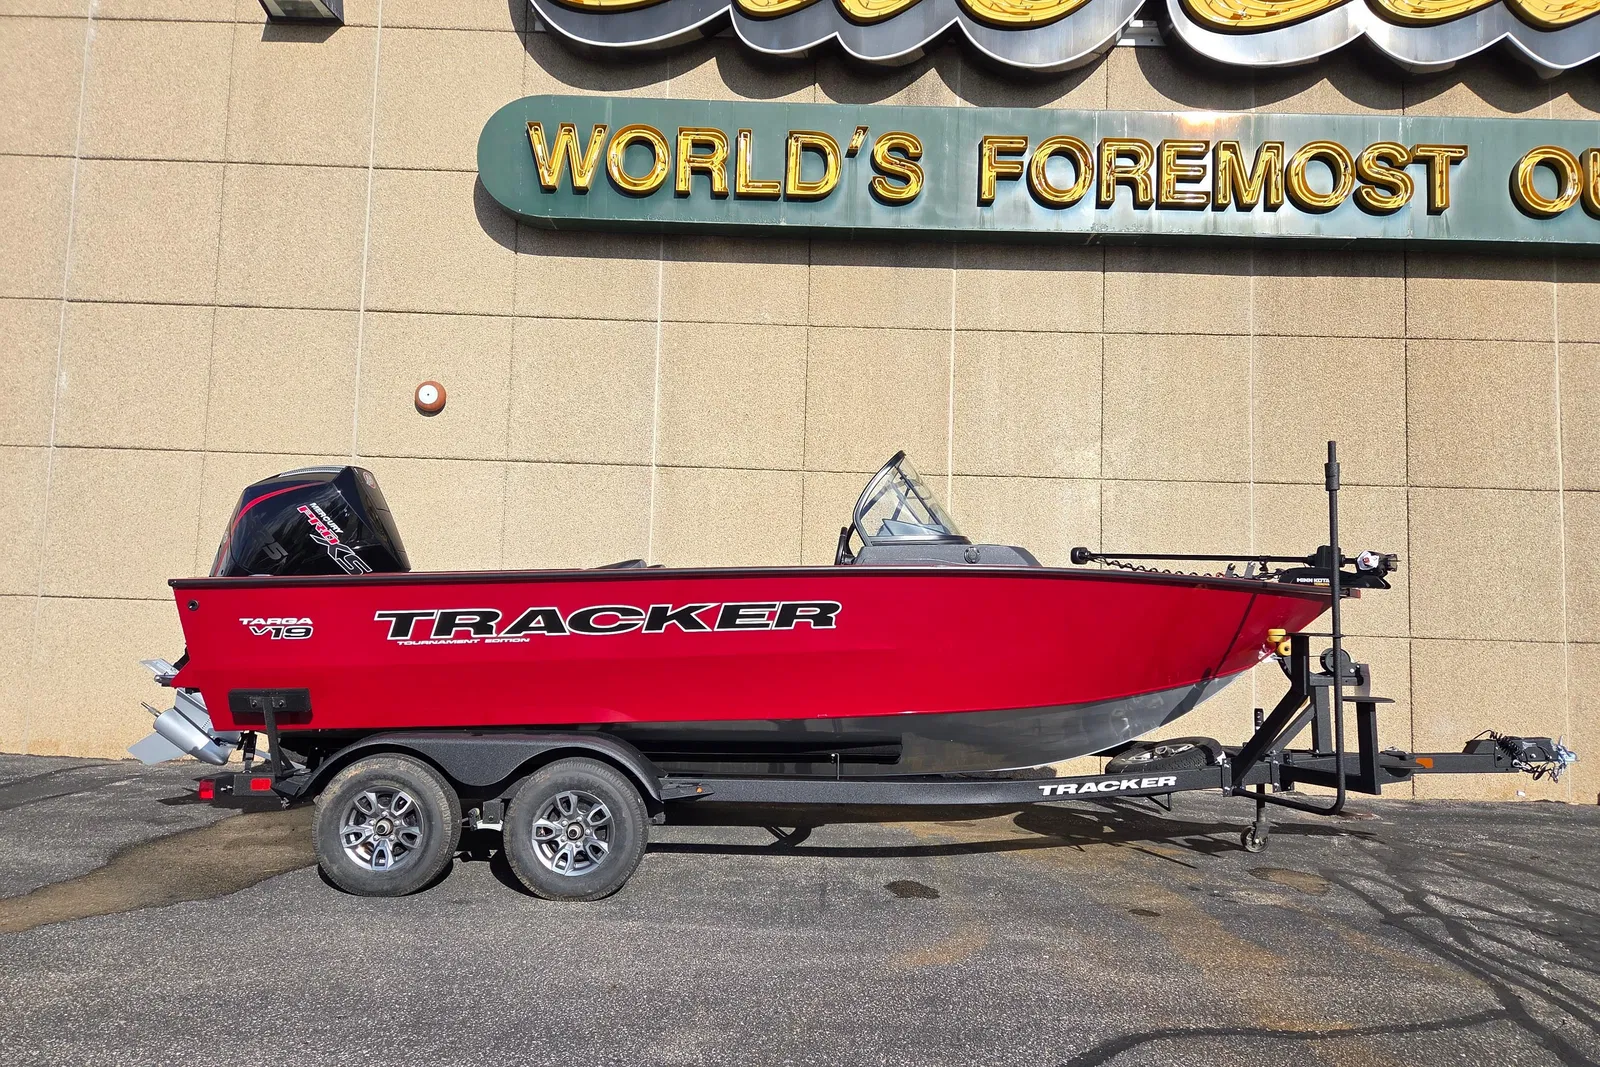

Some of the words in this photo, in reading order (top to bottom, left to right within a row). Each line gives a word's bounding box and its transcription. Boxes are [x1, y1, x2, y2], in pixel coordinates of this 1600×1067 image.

[526, 121, 925, 203] WORLD'S
[978, 134, 1469, 216] FOREMOST
[1508, 144, 1600, 221] O
[296, 504, 340, 546] PRO
[309, 502, 344, 533] MERCURY
[309, 533, 373, 576] XS
[238, 617, 314, 626] TARGA
[248, 625, 314, 640] V19
[373, 600, 843, 641] TRACKER
[1038, 775, 1178, 796] TRACKER
